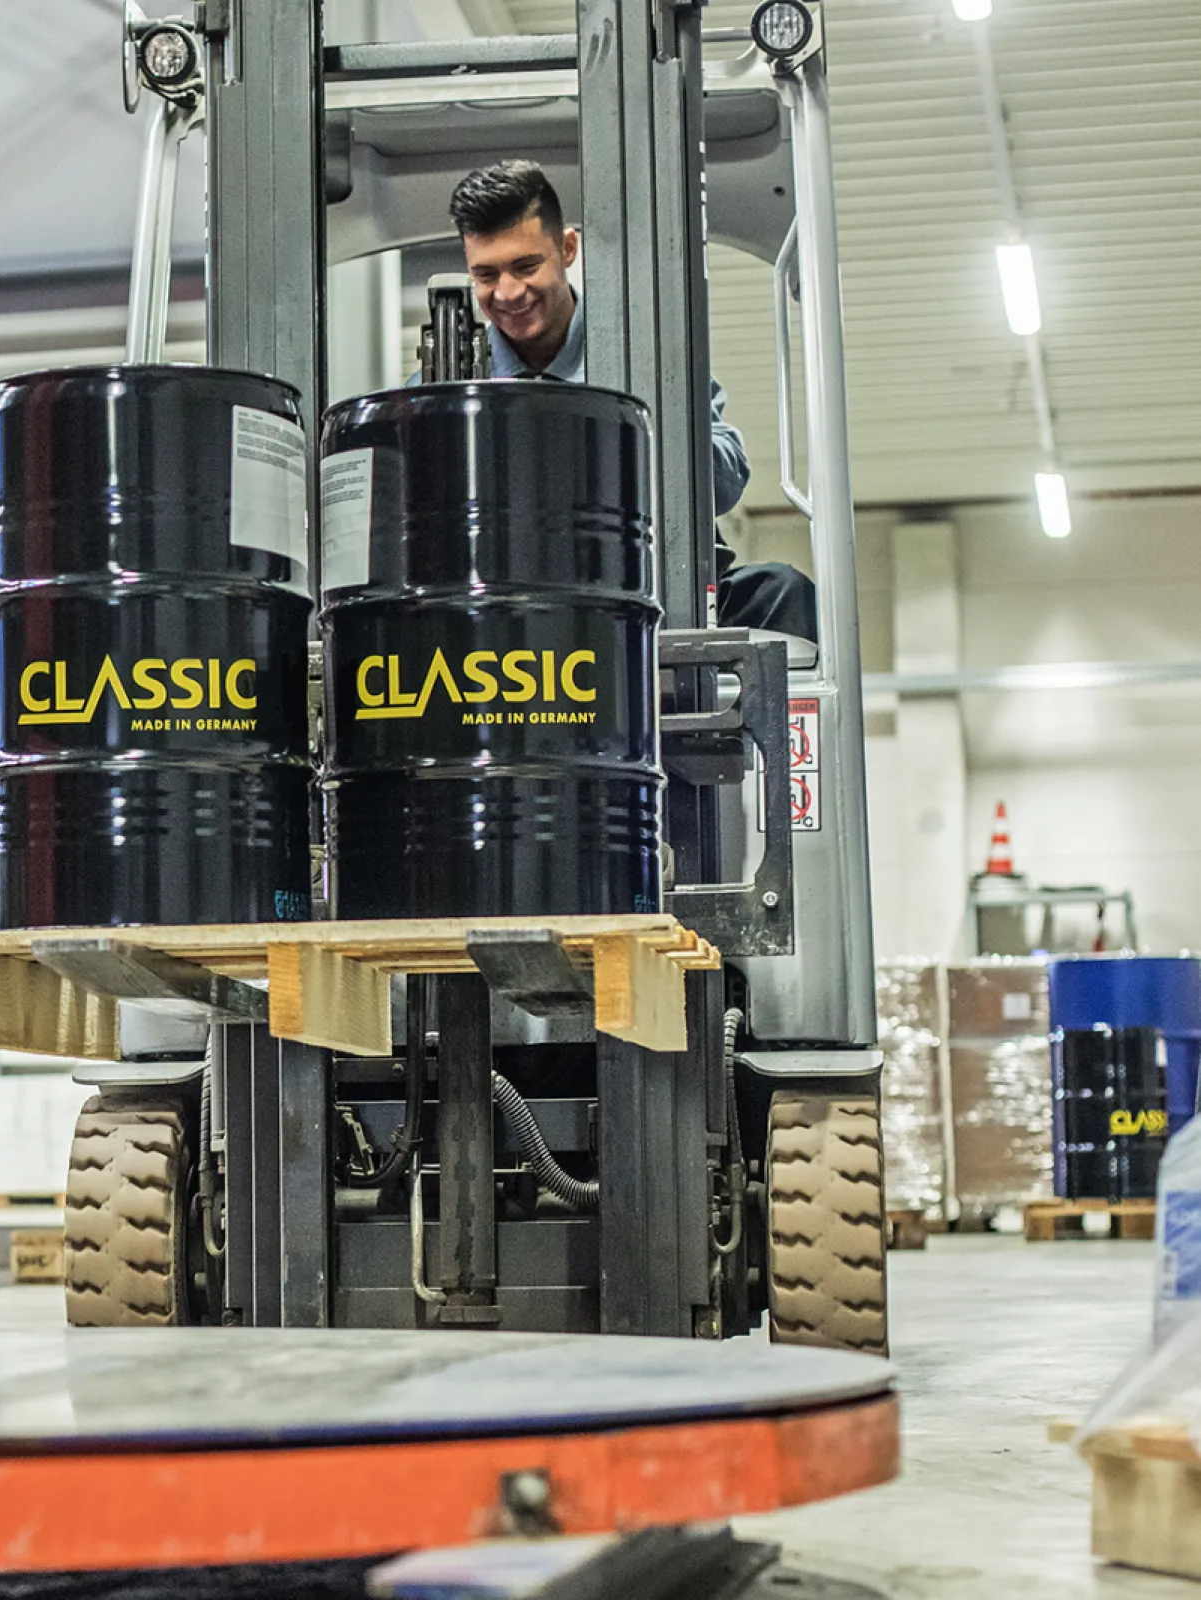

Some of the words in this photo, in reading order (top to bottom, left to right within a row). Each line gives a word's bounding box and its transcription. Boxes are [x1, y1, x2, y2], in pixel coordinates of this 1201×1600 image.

[18, 653, 257, 725] CLASSIC
[355, 646, 596, 720] CLASSIC
[131, 719, 171, 731] MADE
[175, 719, 193, 731] IN
[195, 719, 257, 731] GERMANY
[462, 712, 503, 725] MADE
[508, 712, 524, 724] IN
[529, 712, 596, 724] GERMANY
